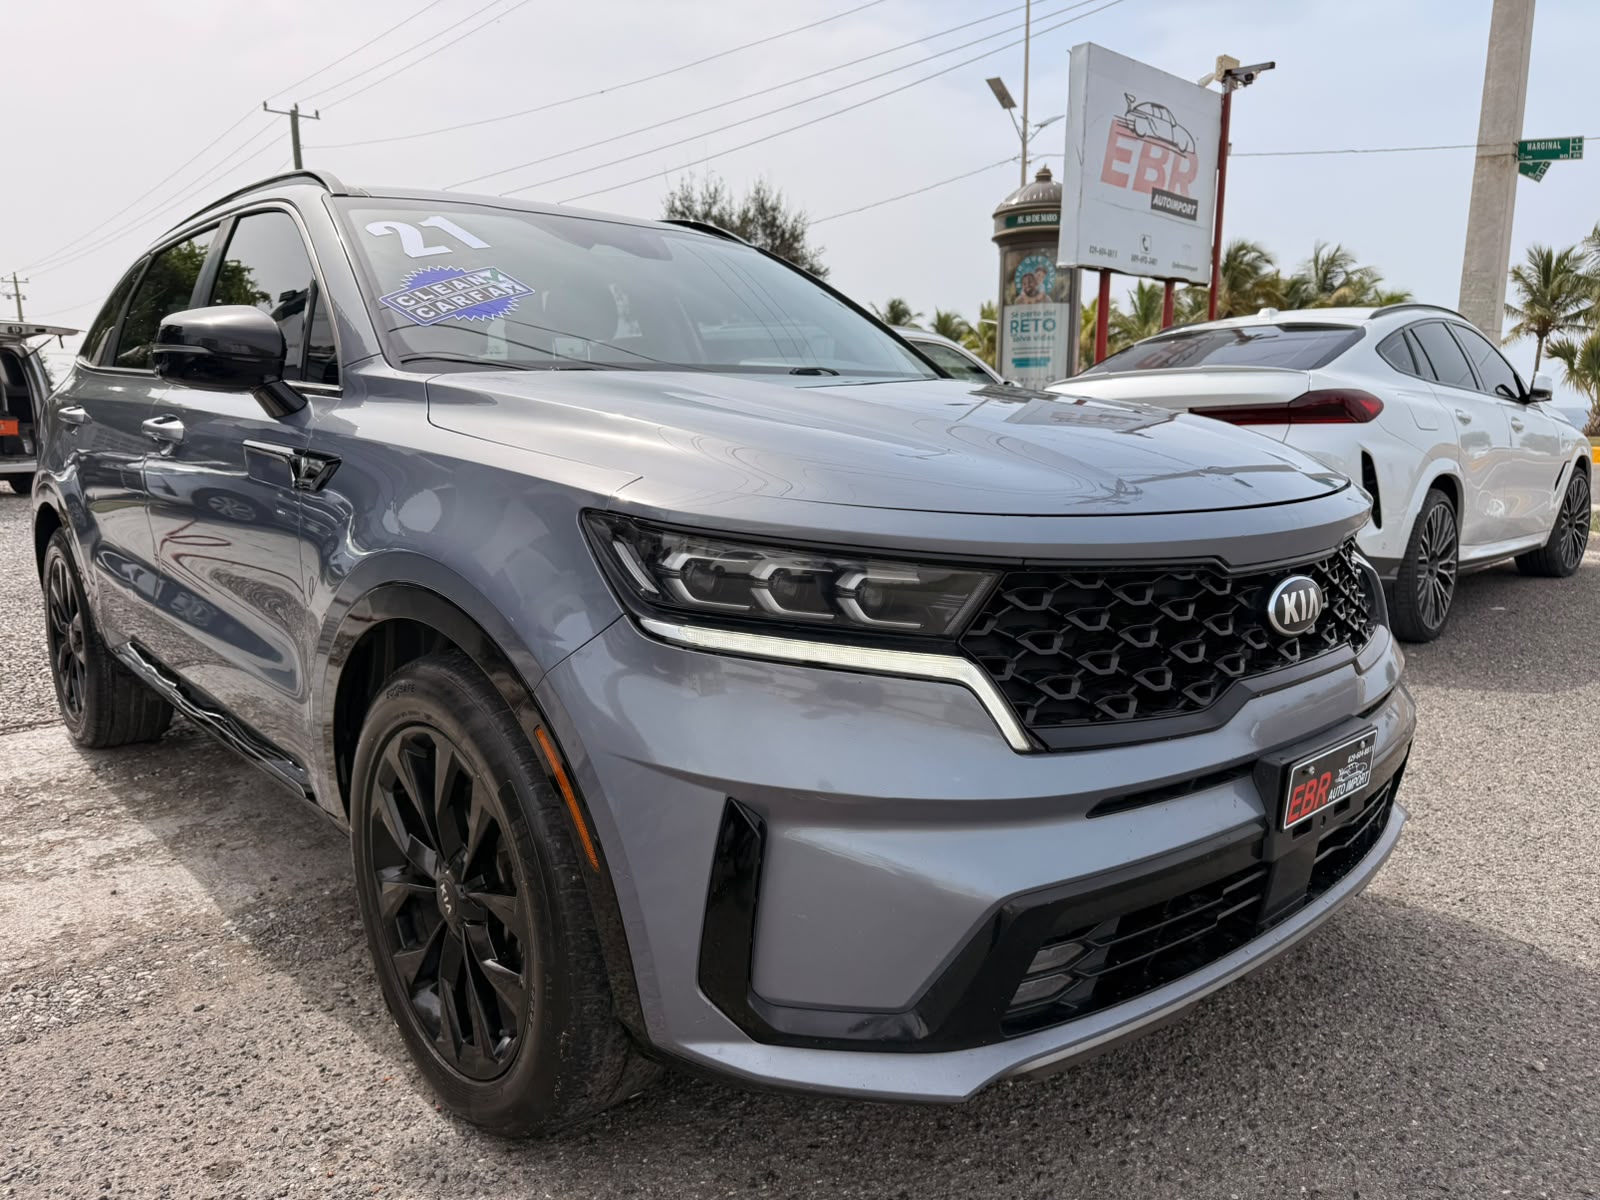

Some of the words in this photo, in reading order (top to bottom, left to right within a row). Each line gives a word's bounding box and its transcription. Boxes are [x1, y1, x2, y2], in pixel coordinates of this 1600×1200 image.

[1100, 118, 1199, 198] EBR
[1527, 141, 1561, 151] MARGINAL
[1152, 194, 1197, 215] AUTOIMPORT
[365, 216, 492, 258] 21
[396, 274, 488, 306] CLEAN
[415, 282, 523, 318] CARFAX
[1010, 318, 1056, 334] RETO
[1281, 587, 1319, 625] KIA
[1286, 771, 1332, 824] EBR
[1328, 782, 1346, 802] AUTO
[1345, 770, 1370, 793] IMPORT
[440, 883, 452, 914] KIA
